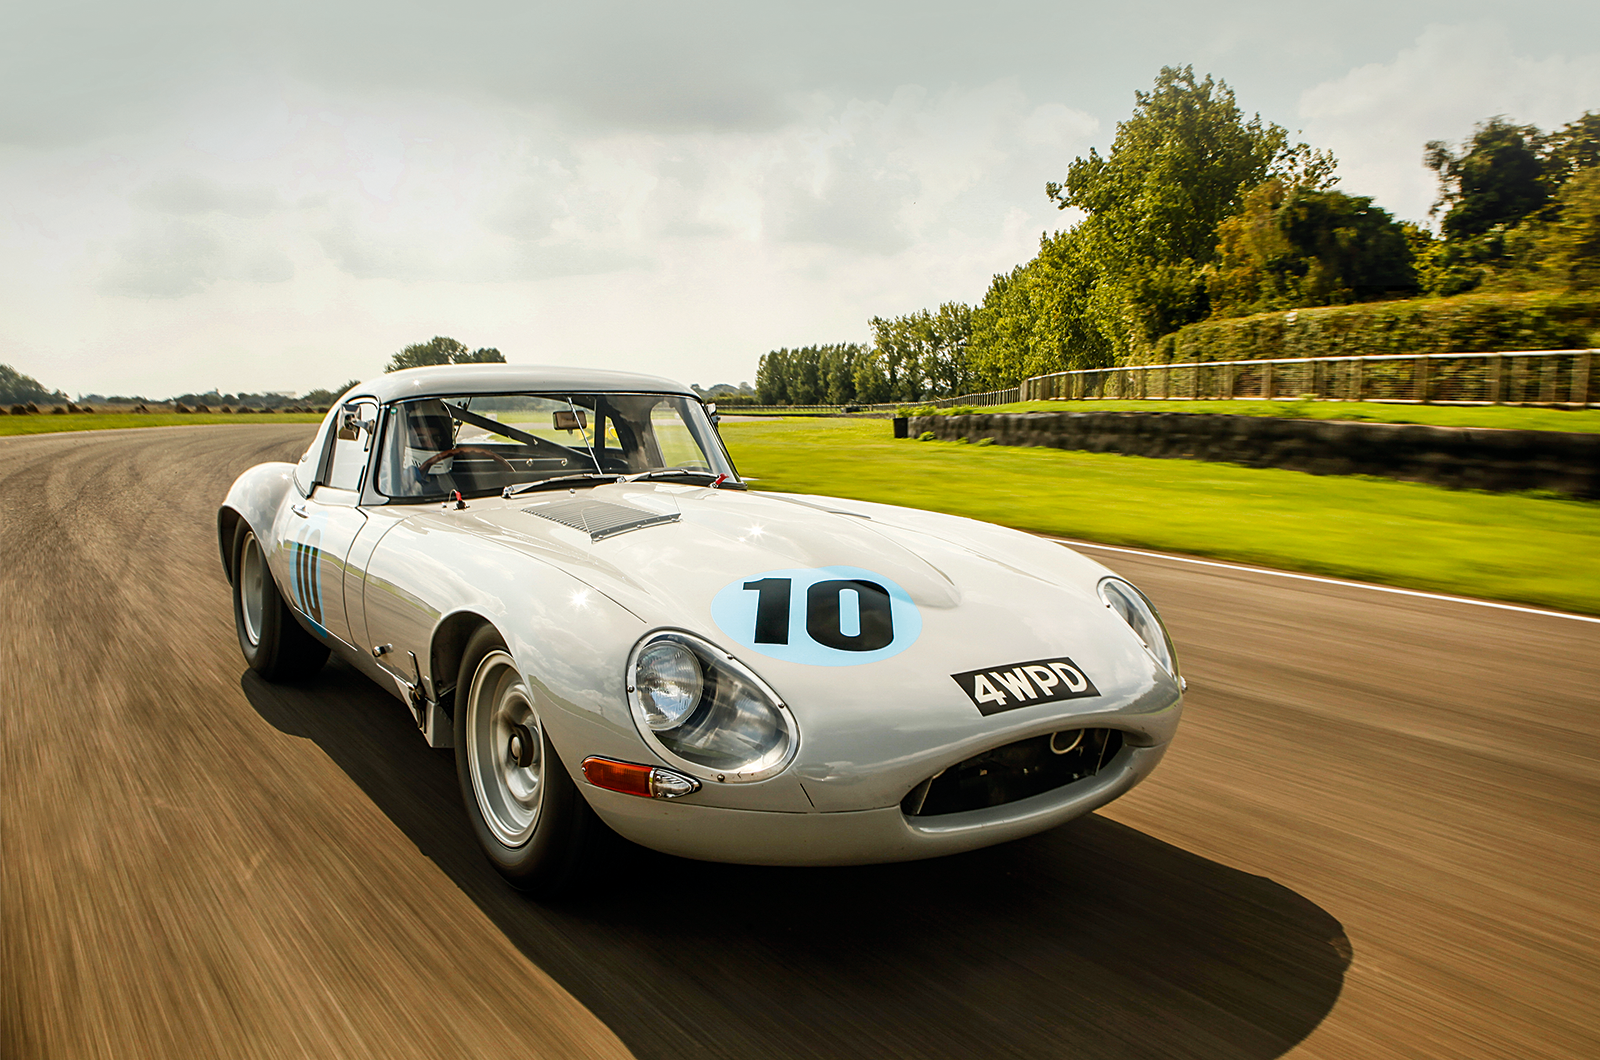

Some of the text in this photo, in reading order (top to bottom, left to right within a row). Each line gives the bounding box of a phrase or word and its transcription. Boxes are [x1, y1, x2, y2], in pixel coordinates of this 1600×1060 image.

[296, 524, 322, 625] 10
[743, 577, 894, 652] 10
[974, 662, 1088, 706] 4WPD
